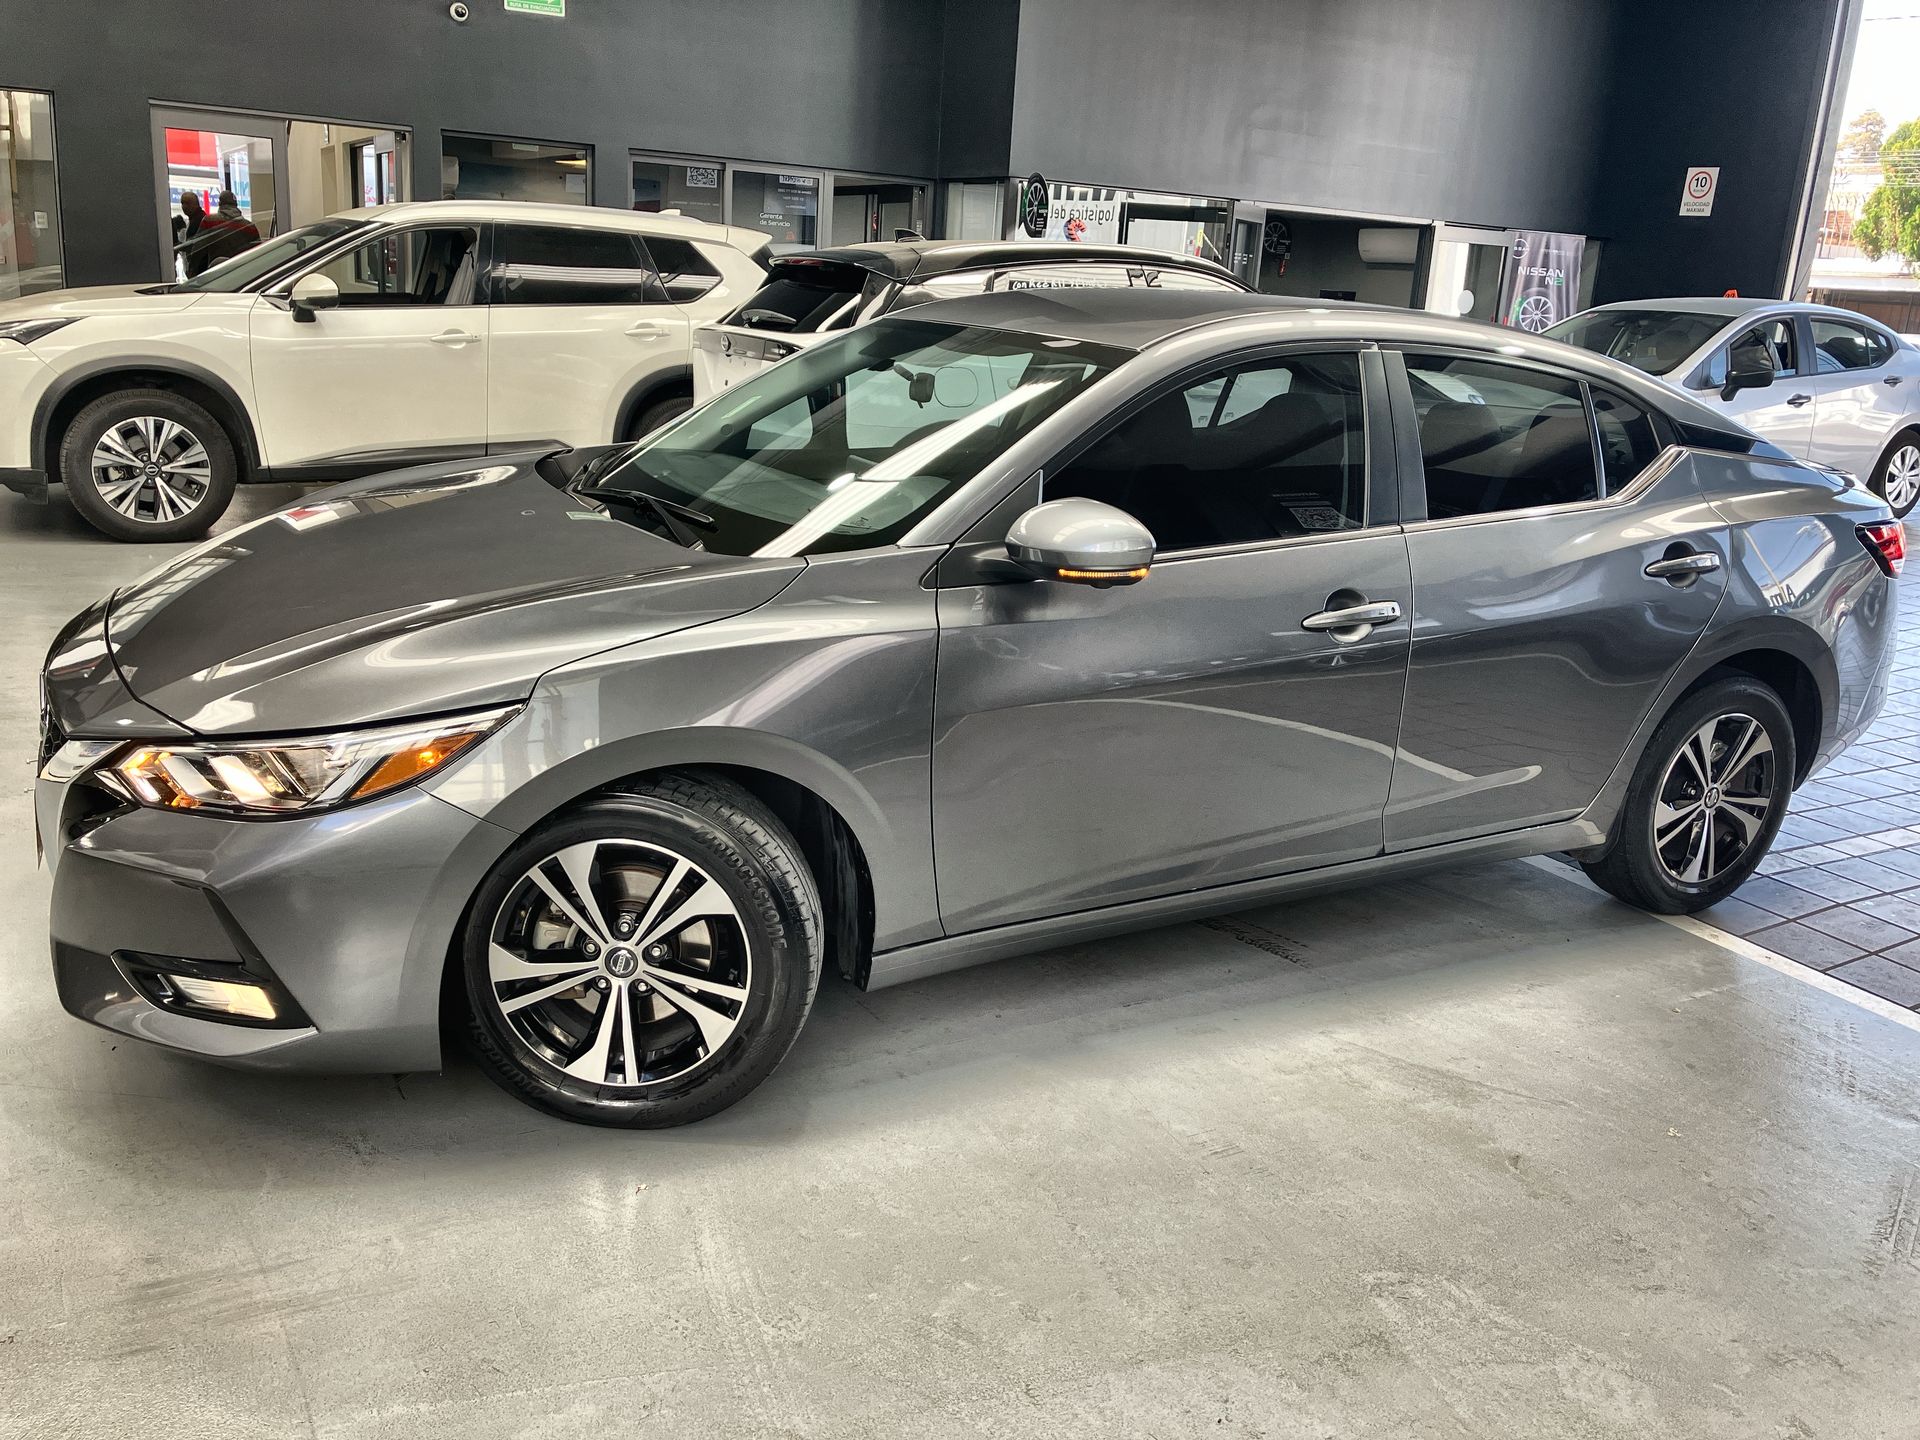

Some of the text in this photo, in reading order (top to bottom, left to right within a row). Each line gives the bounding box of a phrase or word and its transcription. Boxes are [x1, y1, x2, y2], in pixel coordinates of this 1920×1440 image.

[1694, 176, 1708, 188] 10
[759, 212, 783, 220] Gerente
[767, 219, 791, 227] Servicio
[1517, 265, 1565, 278] NISSAN
[1545, 276, 1564, 286] N2
[690, 825, 788, 950] BRIDGESTONE
